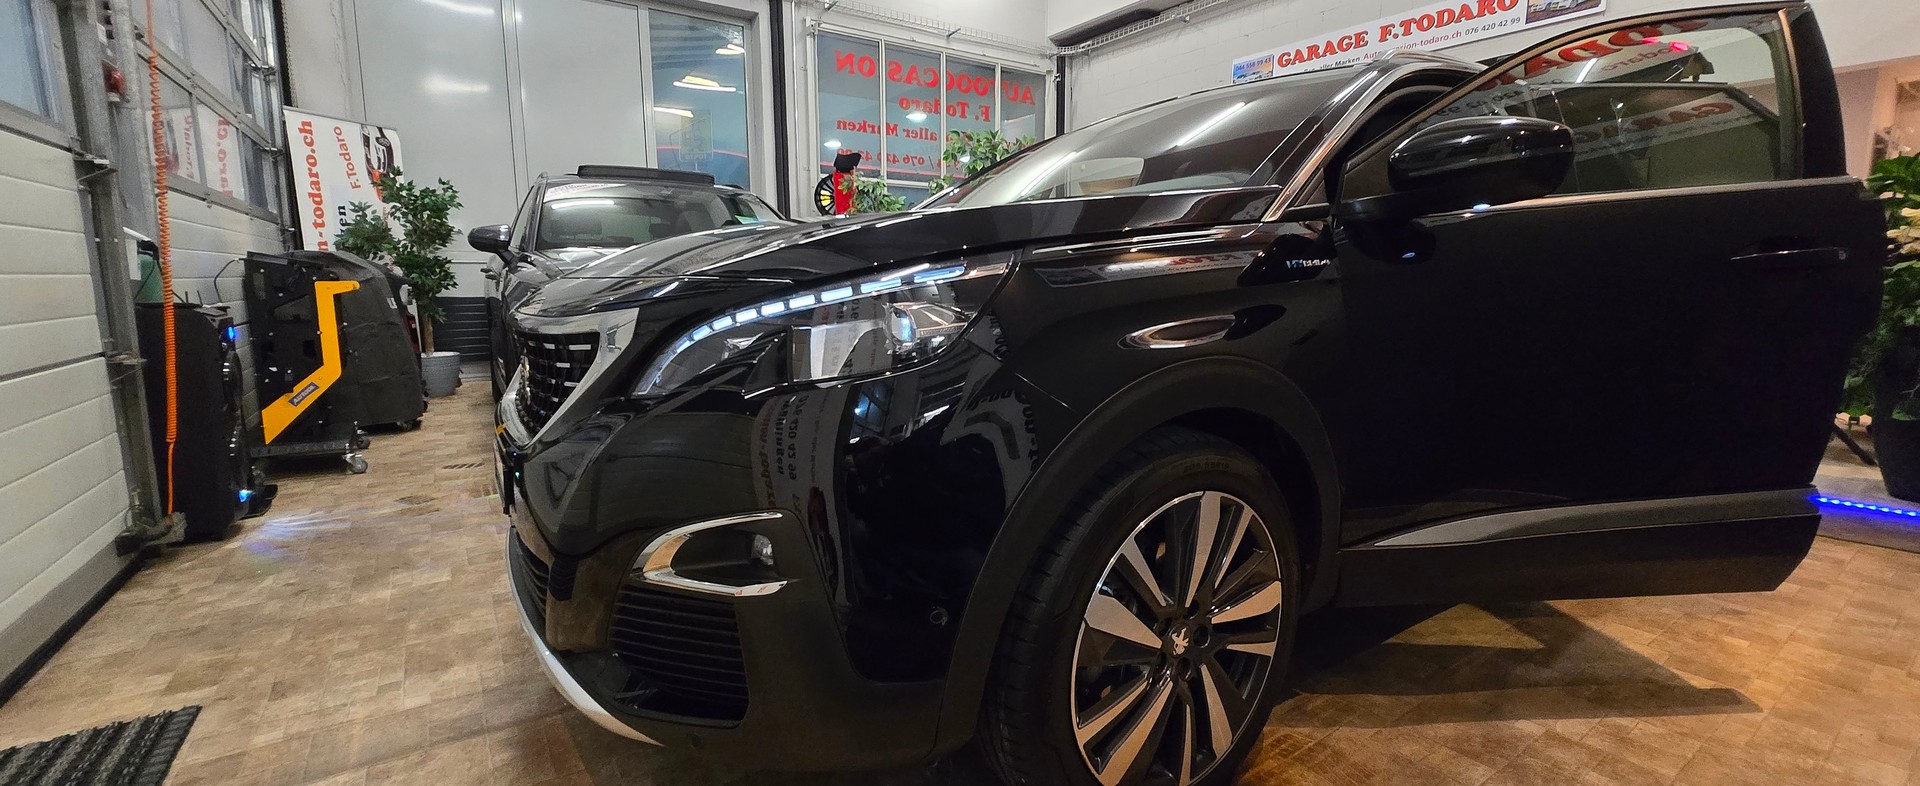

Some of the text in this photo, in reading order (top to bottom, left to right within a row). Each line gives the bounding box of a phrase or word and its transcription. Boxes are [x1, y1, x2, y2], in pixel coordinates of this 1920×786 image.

[1277, 31, 1369, 68] GARAGE
[1335, 56, 1360, 67] Marken
[1464, 26, 1480, 36] 076
[1480, 22, 1496, 32] 420
[1497, 20, 1508, 28] 42
[1510, 16, 1521, 26] 99
[1235, 64, 1245, 72] 044
[1264, 57, 1271, 65] 43
